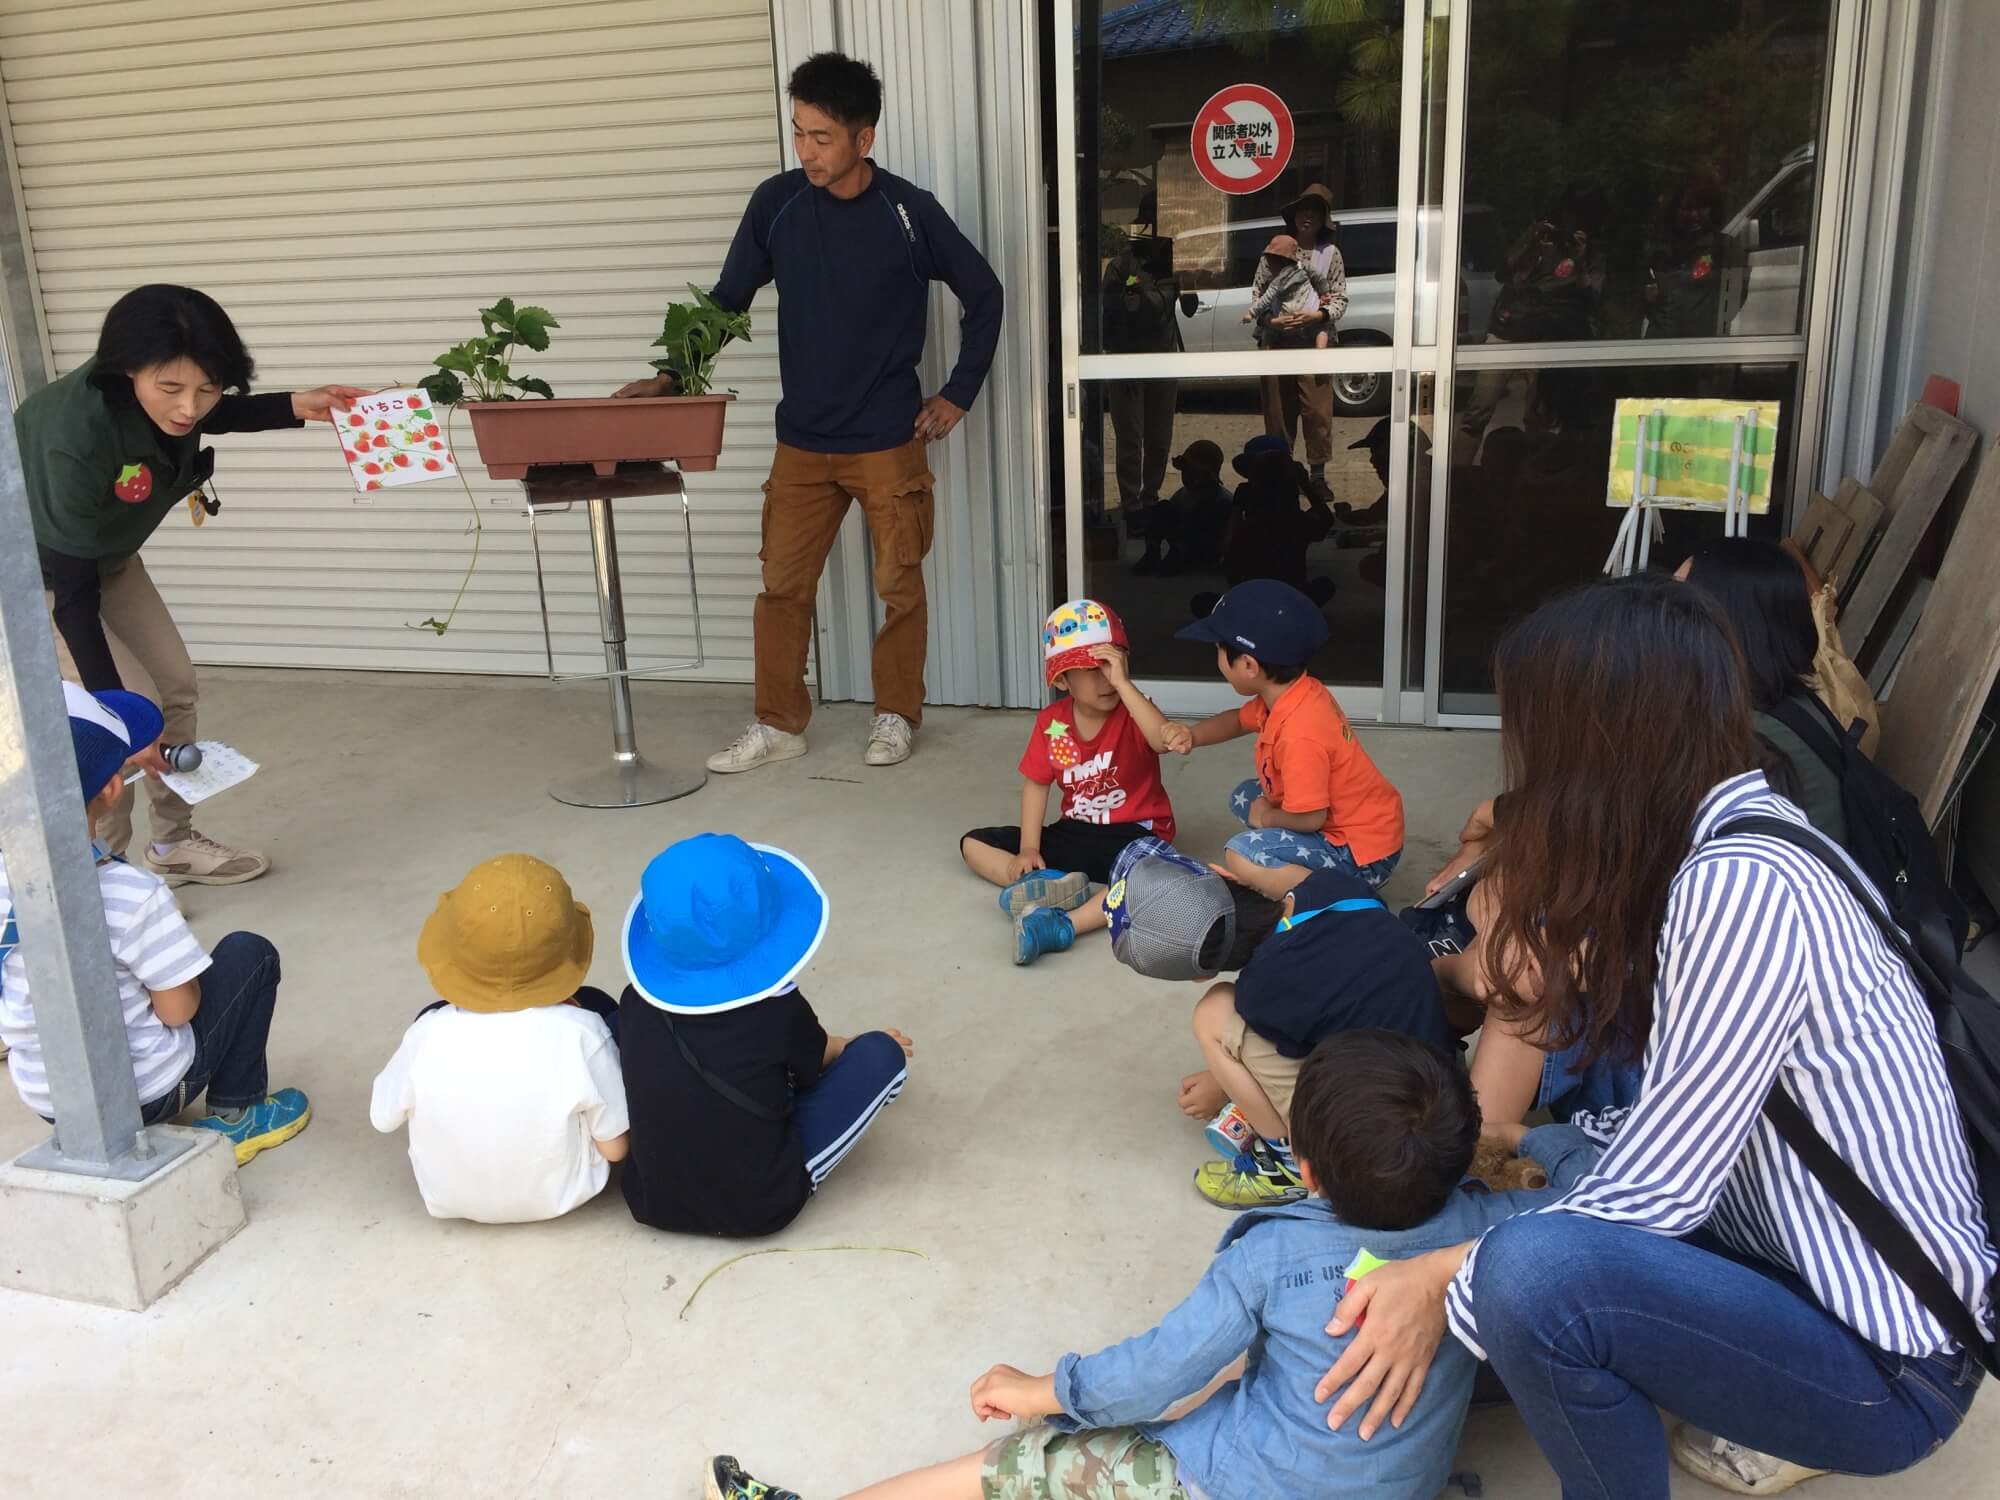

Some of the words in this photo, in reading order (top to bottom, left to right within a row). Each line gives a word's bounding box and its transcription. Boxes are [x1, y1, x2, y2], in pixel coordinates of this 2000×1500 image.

[1212, 122, 1272, 140] 関係者以外
[1212, 141, 1272, 159] 立入禁止
[1284, 1270, 1313, 1288] THE
